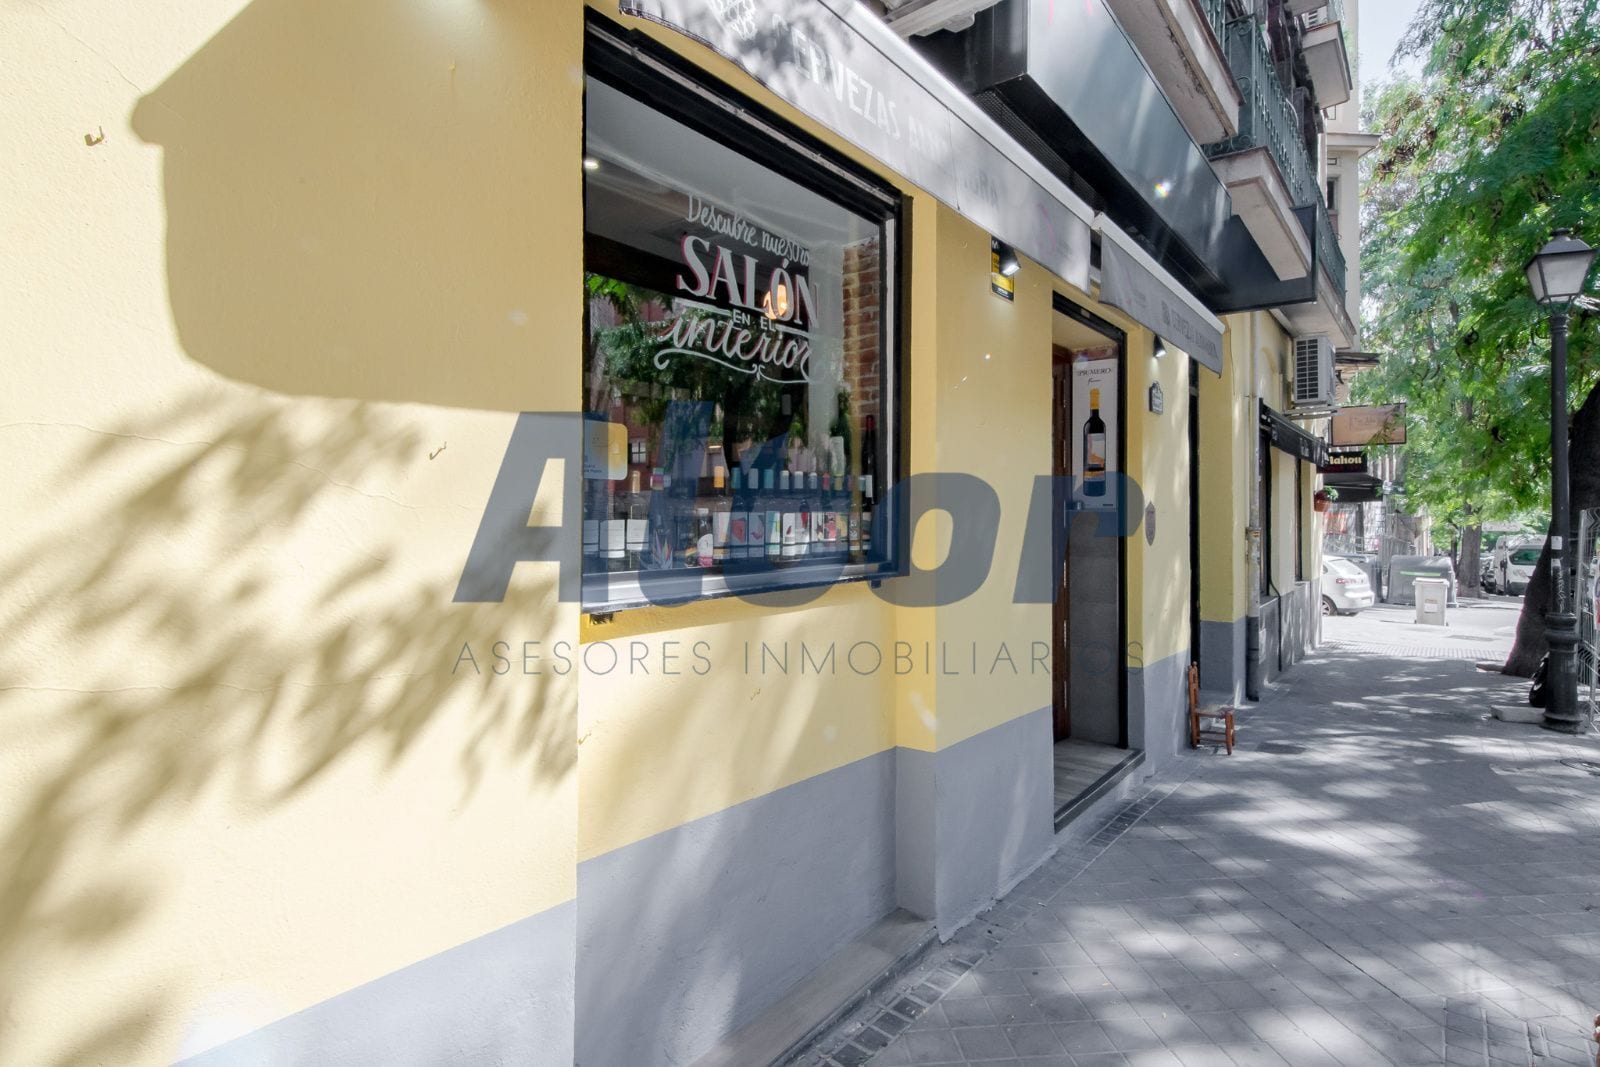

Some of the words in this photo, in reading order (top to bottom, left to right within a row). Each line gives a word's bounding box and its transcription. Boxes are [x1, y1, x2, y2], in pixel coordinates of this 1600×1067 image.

[685, 194, 758, 247] Descubre
[677, 234, 820, 328] SALÓN
[657, 315, 814, 374] interior
[732, 309, 751, 327] EN
[760, 317, 777, 333] EL
